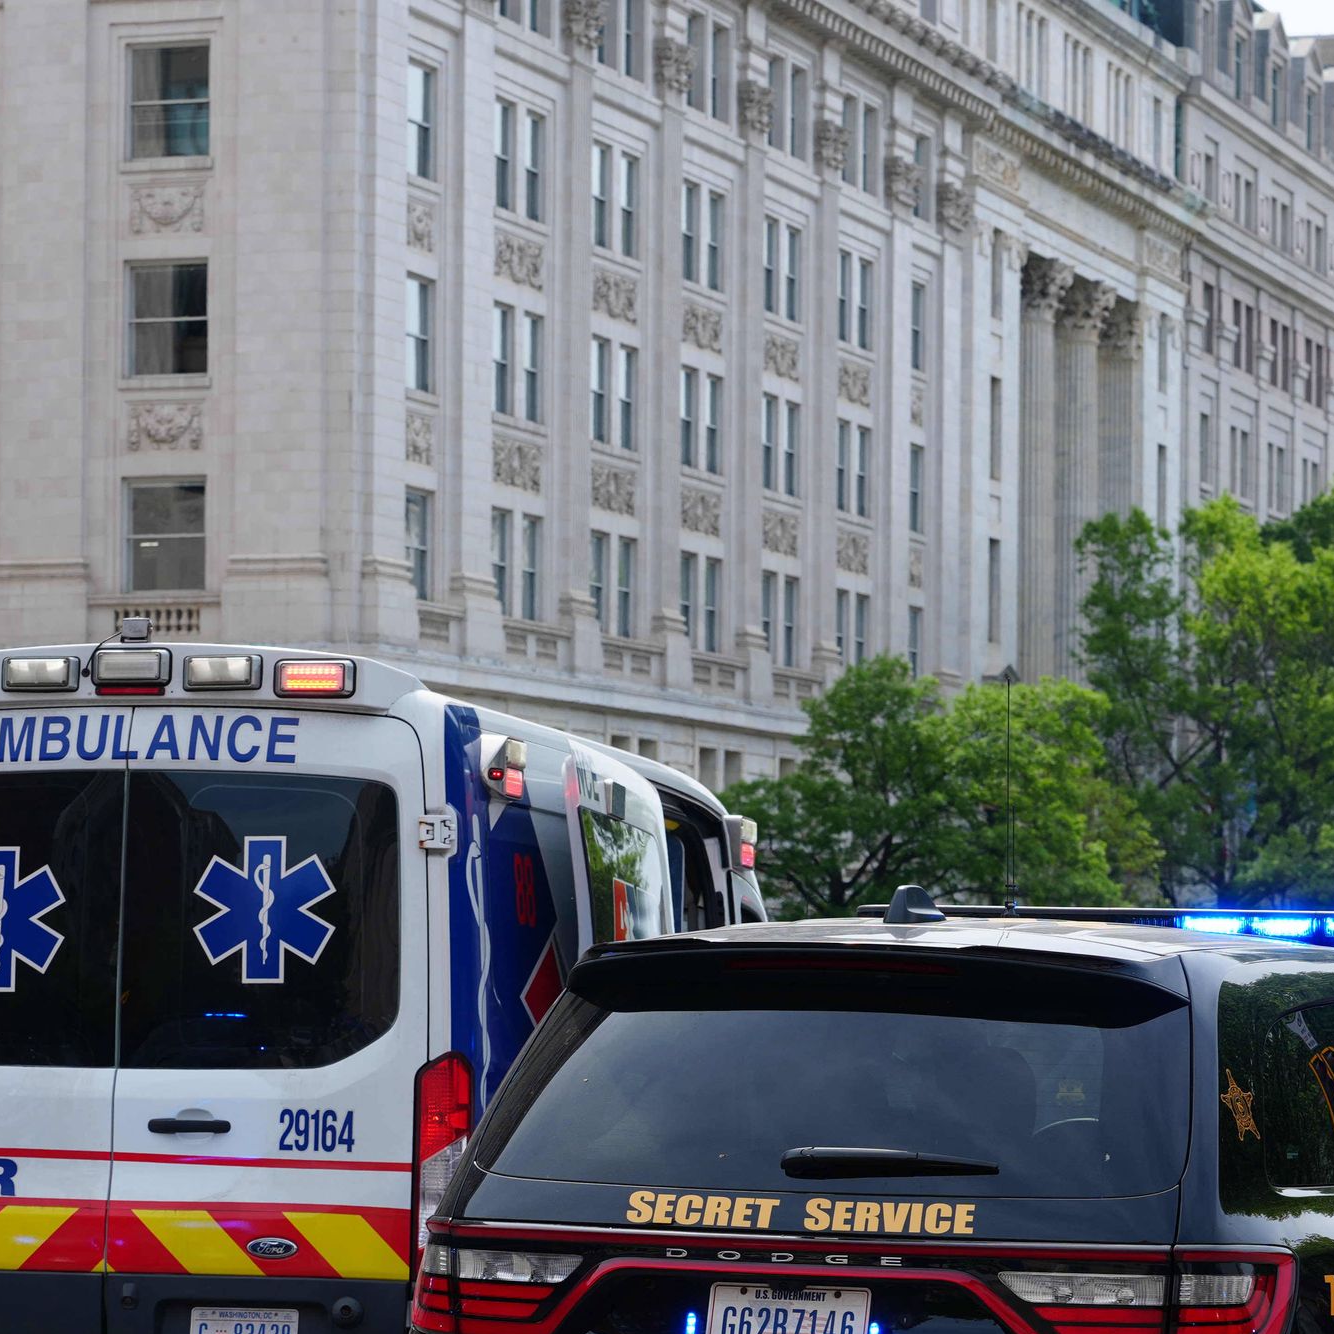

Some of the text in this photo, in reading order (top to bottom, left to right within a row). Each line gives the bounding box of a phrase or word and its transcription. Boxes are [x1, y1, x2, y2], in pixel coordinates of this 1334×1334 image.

[278, 1108, 355, 1153] 29164
[625, 1190, 976, 1235] SECRET SERVICE
[257, 1241, 286, 1254] Ford
[666, 1248, 904, 1267] DODGE
[755, 1289, 827, 1302] U.S. GOVERNMENT
[263, 1312, 273, 1320] DC
